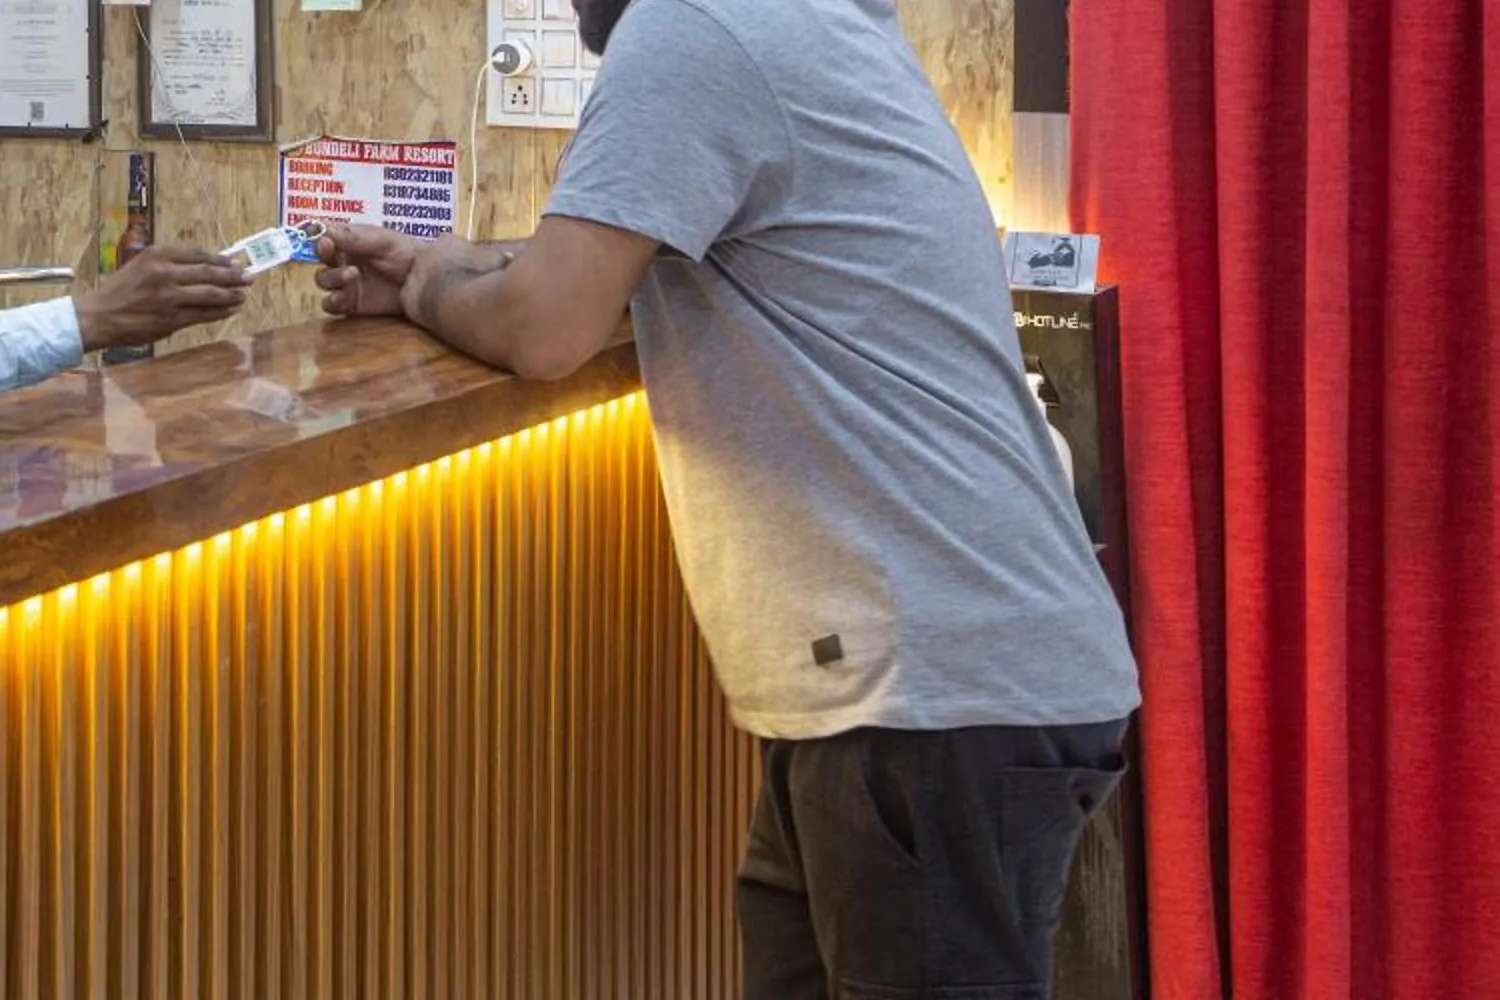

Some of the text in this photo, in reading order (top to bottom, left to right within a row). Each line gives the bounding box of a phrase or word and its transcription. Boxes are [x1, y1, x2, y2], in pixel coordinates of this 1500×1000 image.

[363, 143, 400, 162] FARM
[403, 146, 454, 165] RESORT
[288, 178, 344, 194] RECEPTION
[287, 195, 365, 214] ROOM SERVICE
